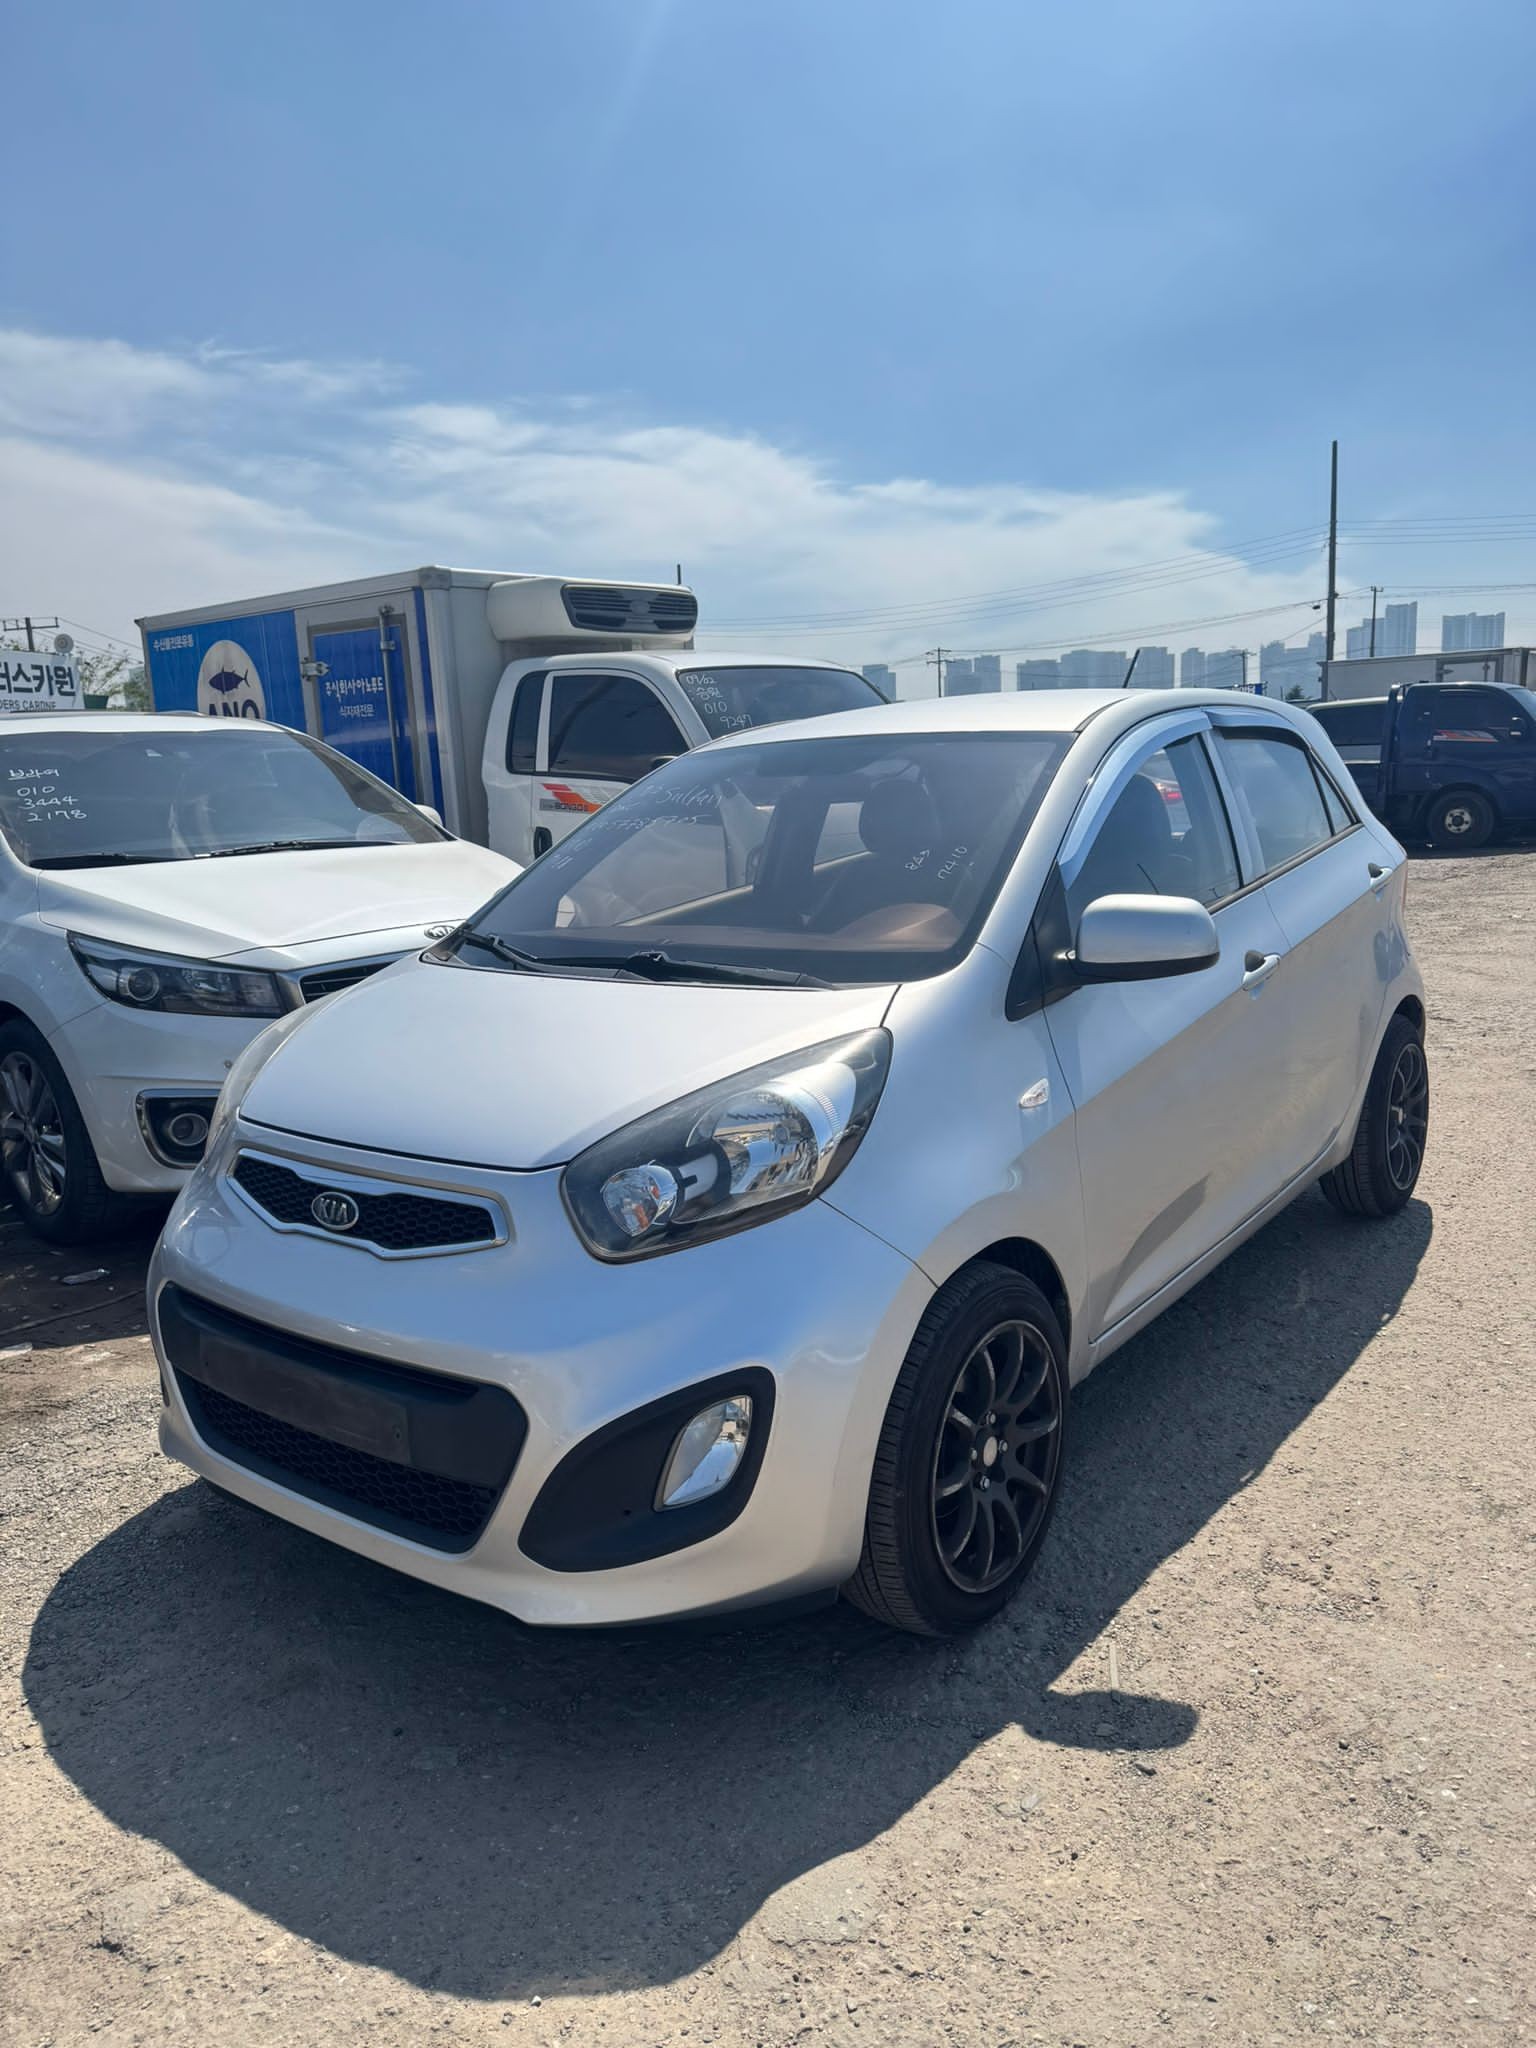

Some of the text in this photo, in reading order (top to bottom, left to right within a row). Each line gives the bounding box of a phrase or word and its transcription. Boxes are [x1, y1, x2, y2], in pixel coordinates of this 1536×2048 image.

[704, 701, 728, 714] 010
[16, 785, 55, 797] 010
[27, 809, 87, 822] 2178
